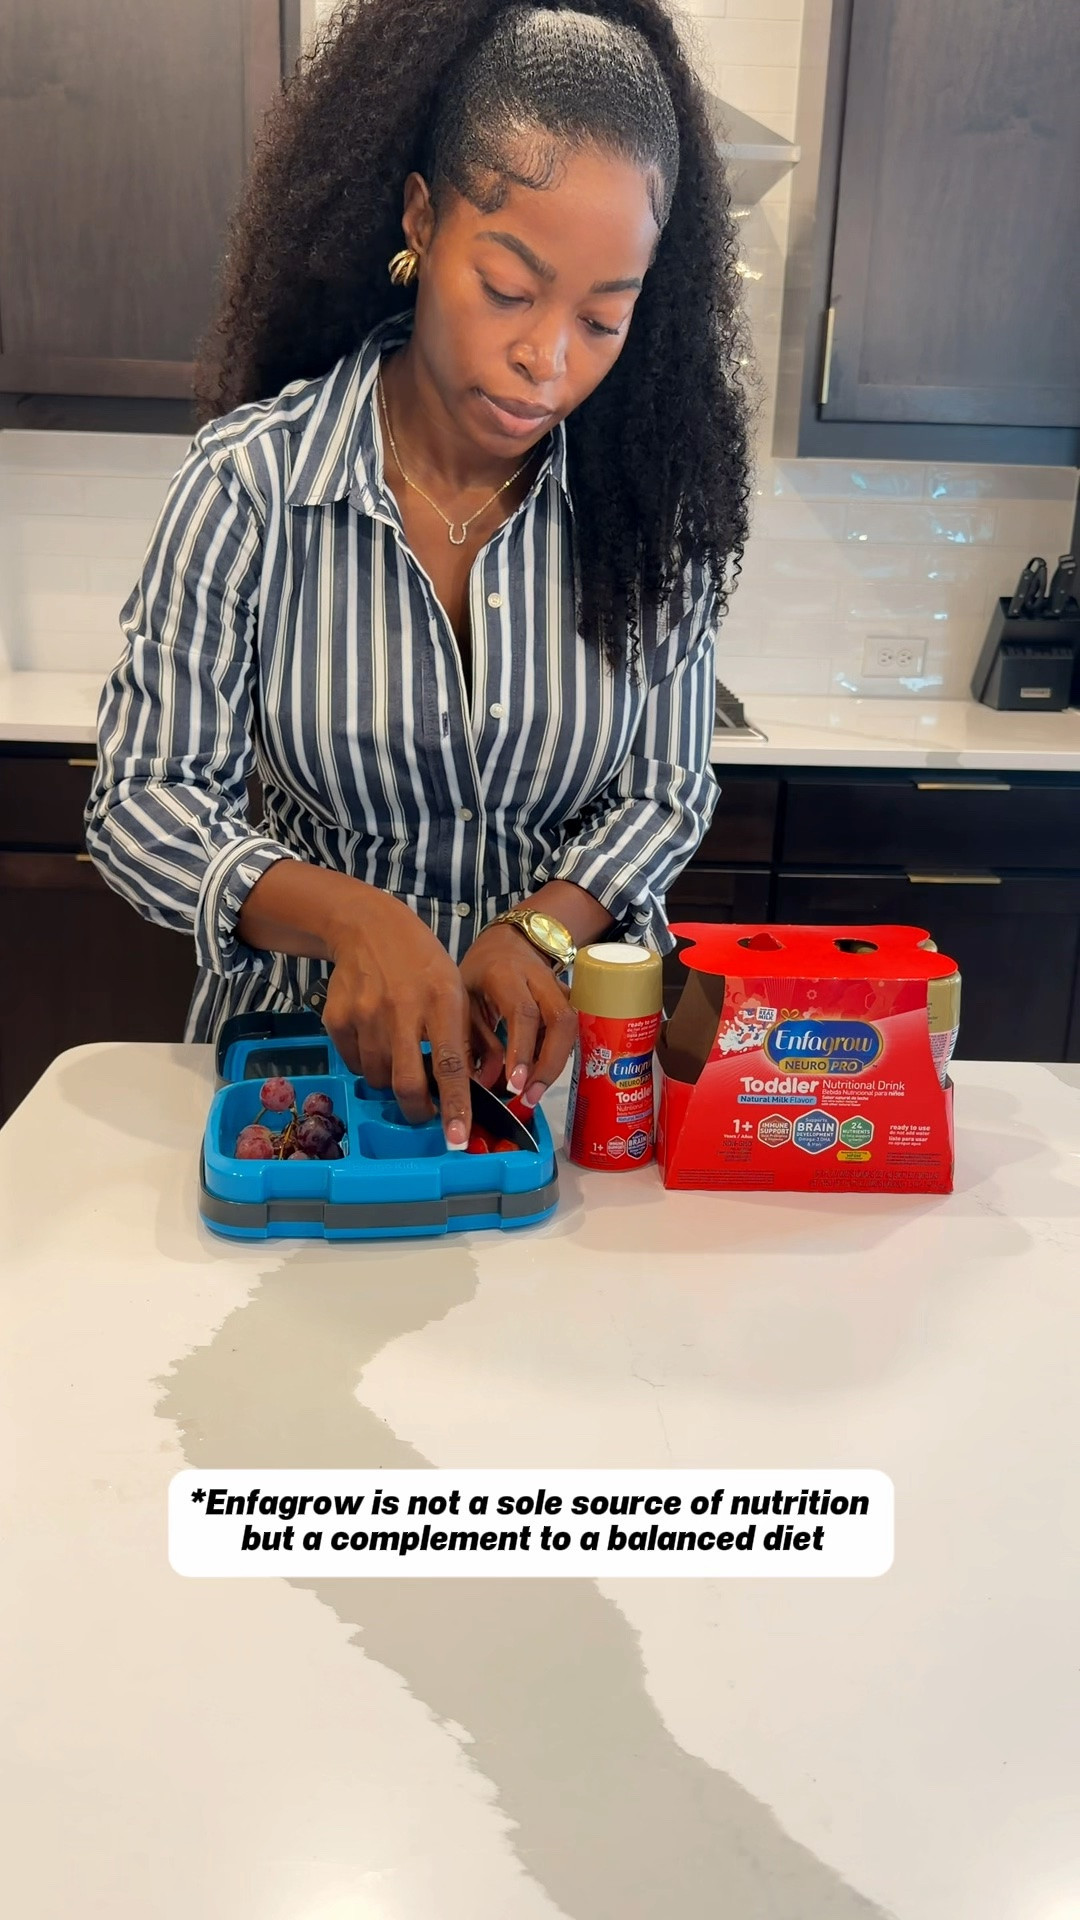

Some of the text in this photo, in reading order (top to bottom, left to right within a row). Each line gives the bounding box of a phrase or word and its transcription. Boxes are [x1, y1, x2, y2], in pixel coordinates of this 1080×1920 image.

[775, 1029, 873, 1057] Enfagrow
[784, 1060, 858, 1072] NEURO PRO
[619, 1079, 640, 1087] NEURO
[739, 1077, 820, 1094] Toddler
[822, 1079, 905, 1090] Nutritional Drink
[771, 1096, 788, 1104] Milk
[789, 1096, 814, 1104] Flavor
[733, 1119, 753, 1133] 1+
[797, 1122, 835, 1132] BRAIN
[592, 1142, 604, 1151] 1+
